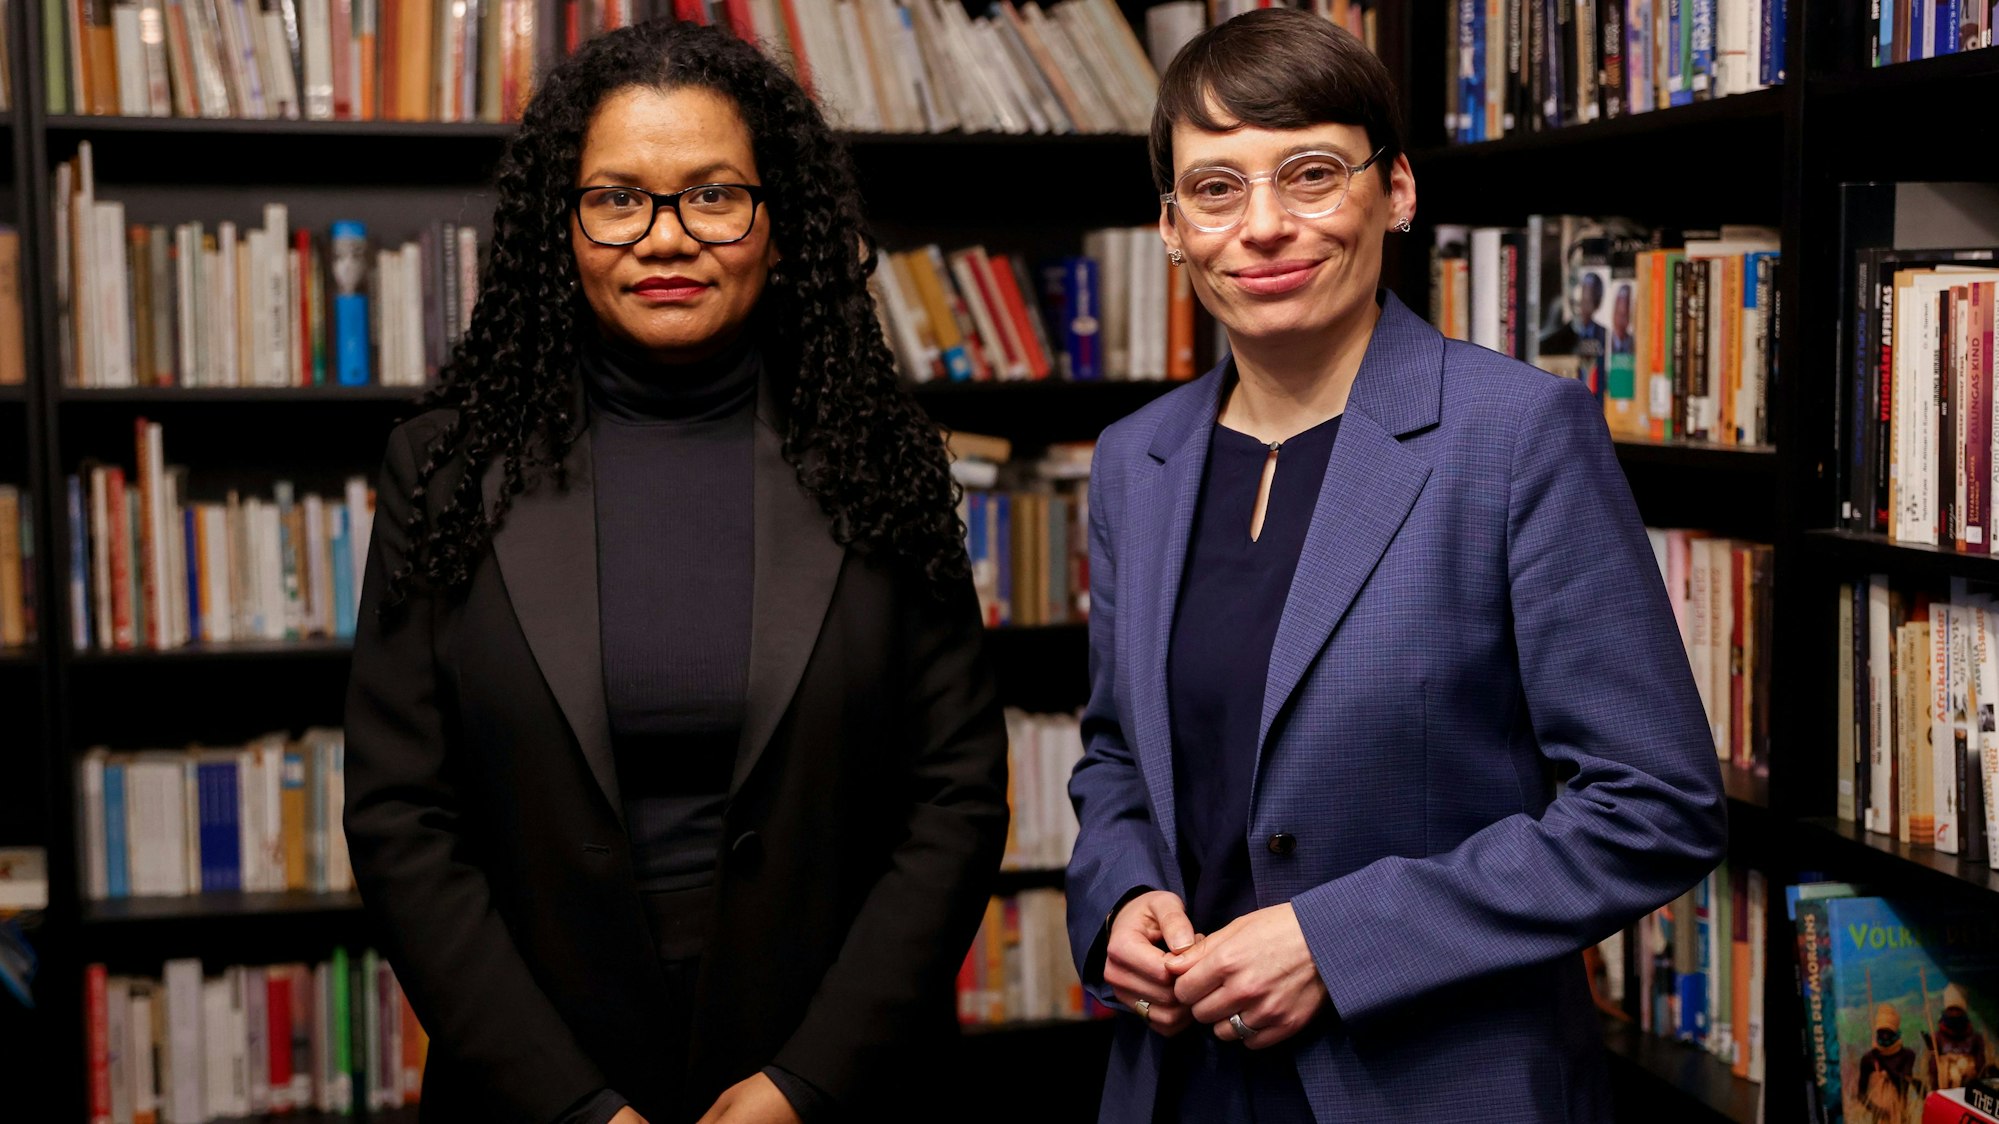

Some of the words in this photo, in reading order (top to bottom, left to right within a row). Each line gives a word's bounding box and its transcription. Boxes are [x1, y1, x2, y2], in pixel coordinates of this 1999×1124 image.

[1881, 285, 1893, 346] AFRIKAS
[1971, 338, 1980, 371] KIND
[1971, 373, 1980, 444] KALUNGAS
[1936, 610, 1946, 722] AfrikaBilder
[1989, 747, 1998, 773] HERZ
[1803, 914, 1821, 992] MORGENS
[1809, 993, 1823, 1021] DES
[1971, 1088, 1994, 1114] THE
